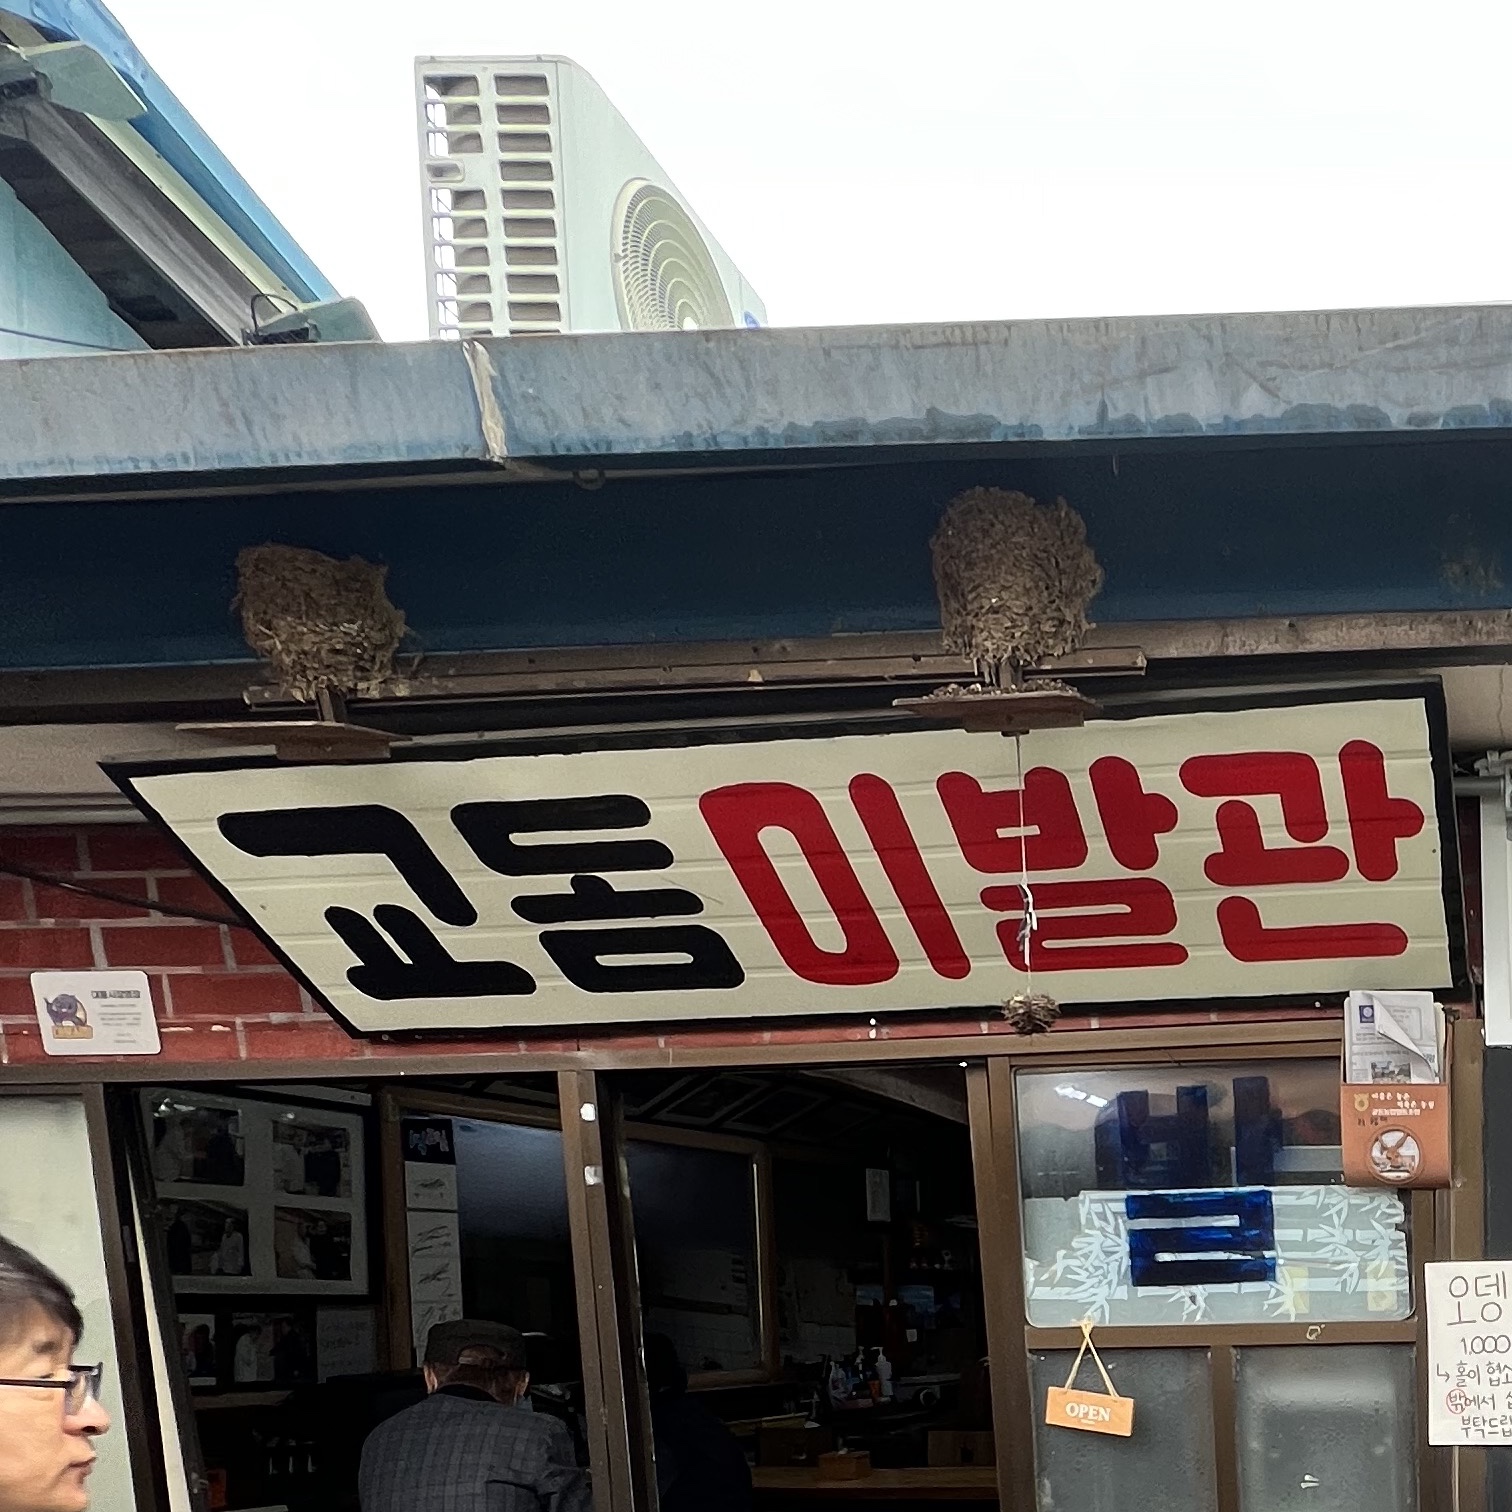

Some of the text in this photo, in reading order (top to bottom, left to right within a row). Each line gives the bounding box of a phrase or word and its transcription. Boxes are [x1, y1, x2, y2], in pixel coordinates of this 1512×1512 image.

[1446, 1270, 1507, 1326] 오뎅
[1455, 1359, 1481, 1388] 홀이
[1065, 1402, 1112, 1422] OPEN
[1448, 1390, 1496, 1412] 밖에서
